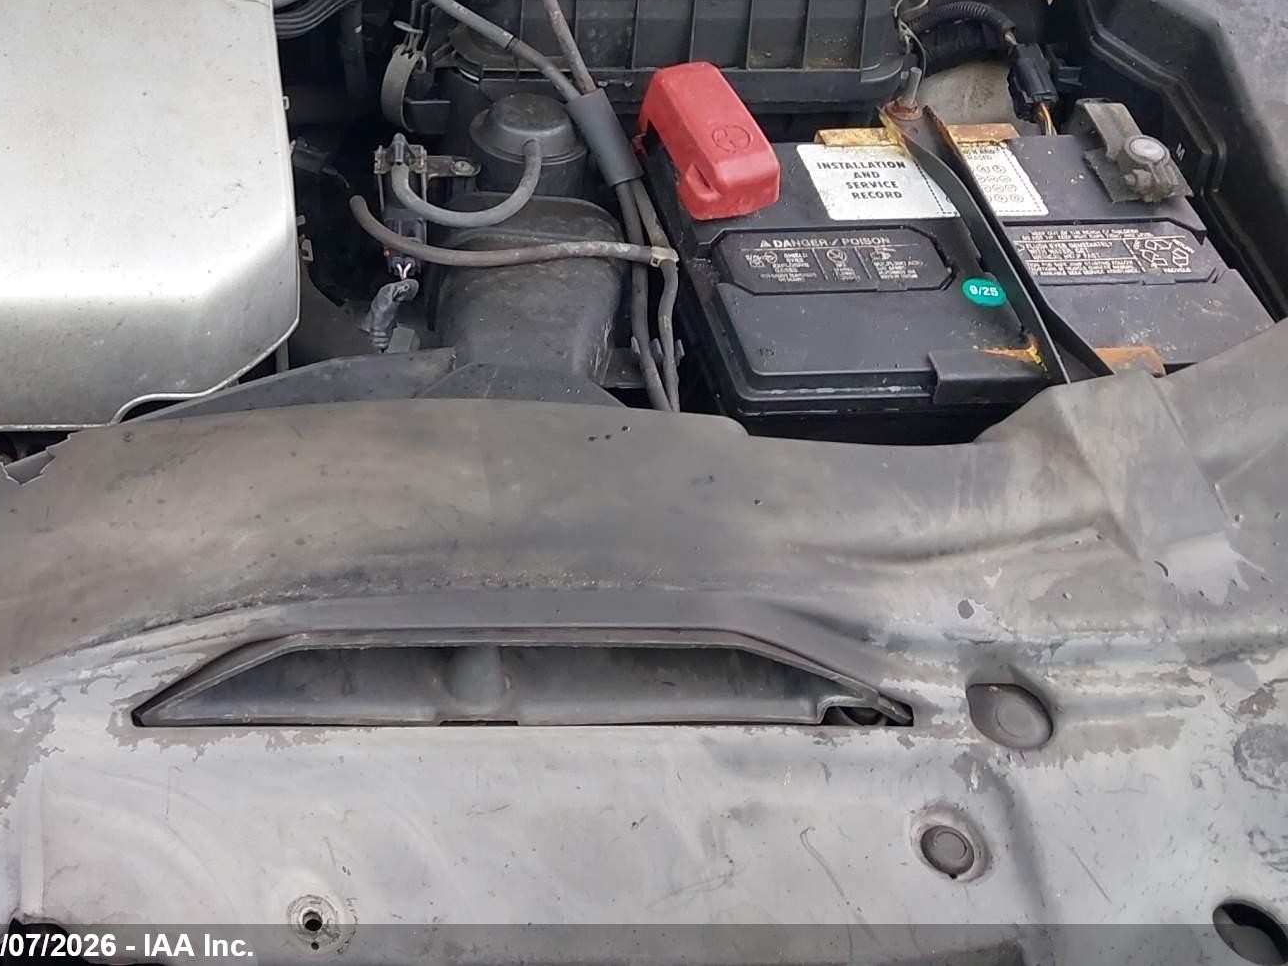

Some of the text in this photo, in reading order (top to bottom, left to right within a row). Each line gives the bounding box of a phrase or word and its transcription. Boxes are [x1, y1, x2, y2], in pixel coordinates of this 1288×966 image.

[816, 161, 906, 170] INSTALLATION
[853, 171, 880, 180] AND
[846, 180, 899, 189] SERVICE
[852, 191, 903, 200] RECORD
[841, 237, 891, 246] POISON
